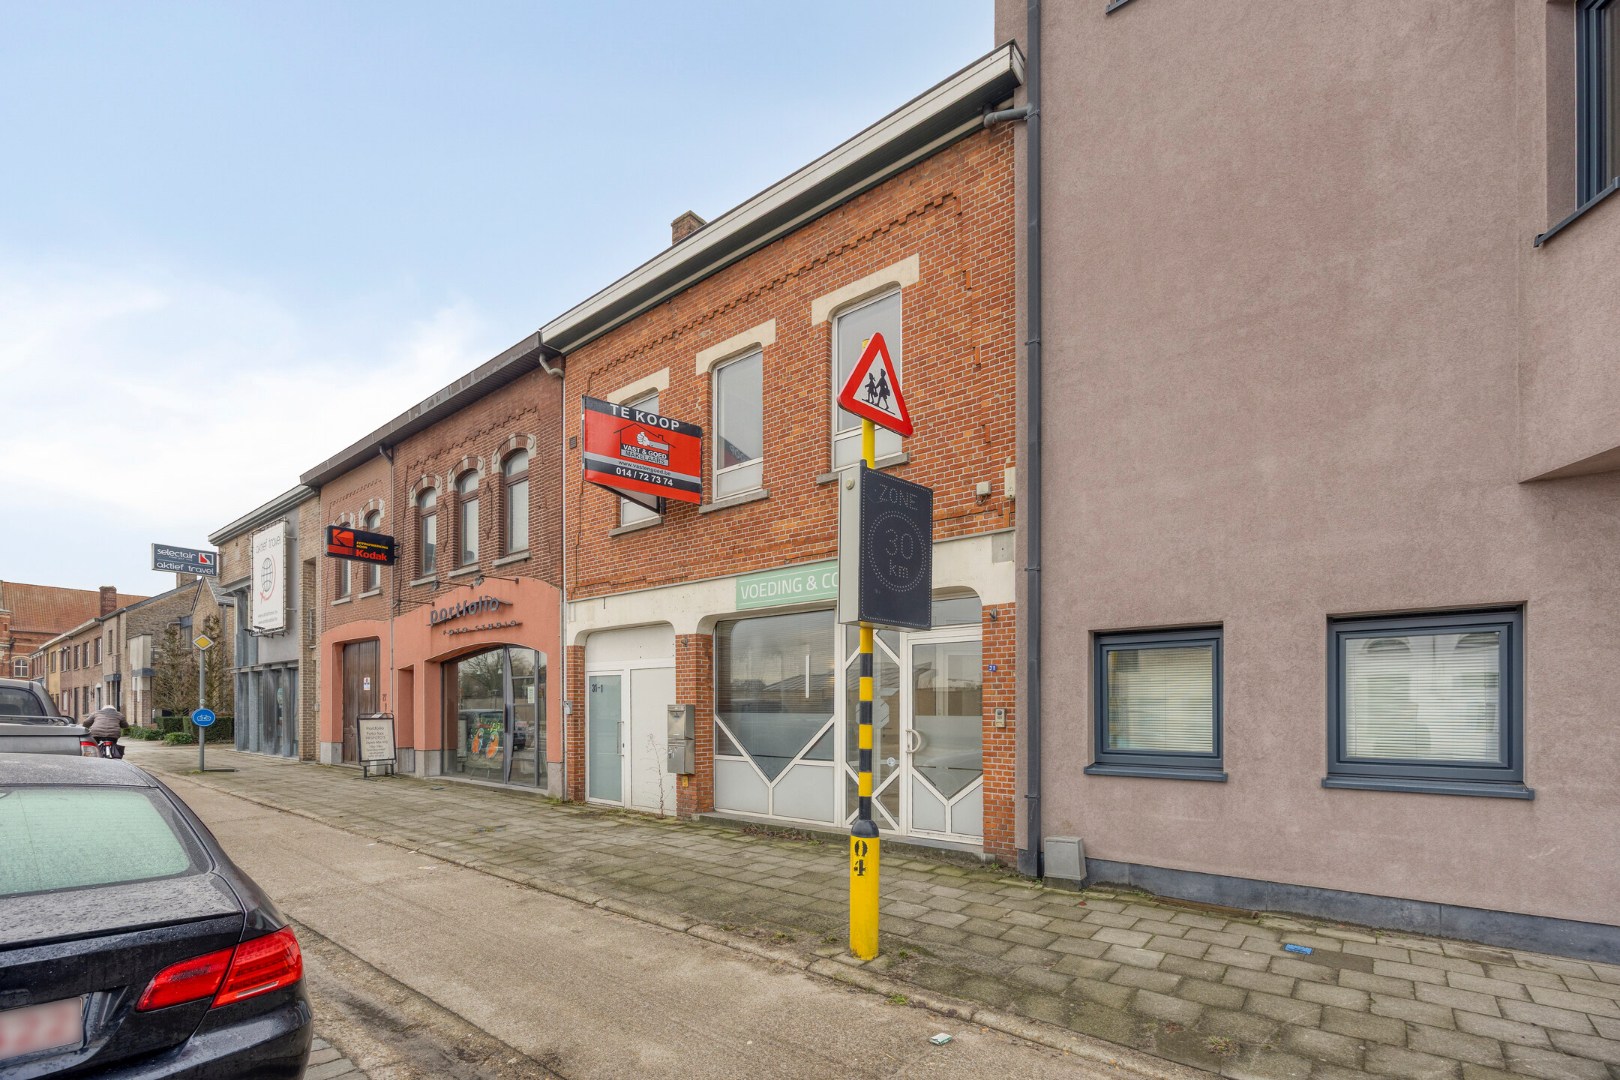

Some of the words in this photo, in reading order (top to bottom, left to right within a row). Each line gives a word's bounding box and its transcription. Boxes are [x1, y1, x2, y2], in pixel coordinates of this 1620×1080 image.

[610, 403, 630, 419] TE
[635, 410, 680, 431] KOOP
[623, 444, 641, 453] VAST
[648, 450, 667, 459] GOED
[616, 467, 632, 478] 014
[633, 470, 637, 479] /
[639, 473, 649, 481] 72
[651, 475, 661, 484] 73
[663, 477, 673, 486] 74
[879, 483, 918, 511] ZONE
[157, 548, 197, 559] selectair
[355, 549, 387, 561] Kodak
[885, 528, 914, 560] 30
[156, 561, 184, 570] aktief
[188, 565, 214, 575] travel
[740, 577, 802, 600] VOEDING
[806, 575, 818, 591] &
[430, 595, 500, 626] portfolio
